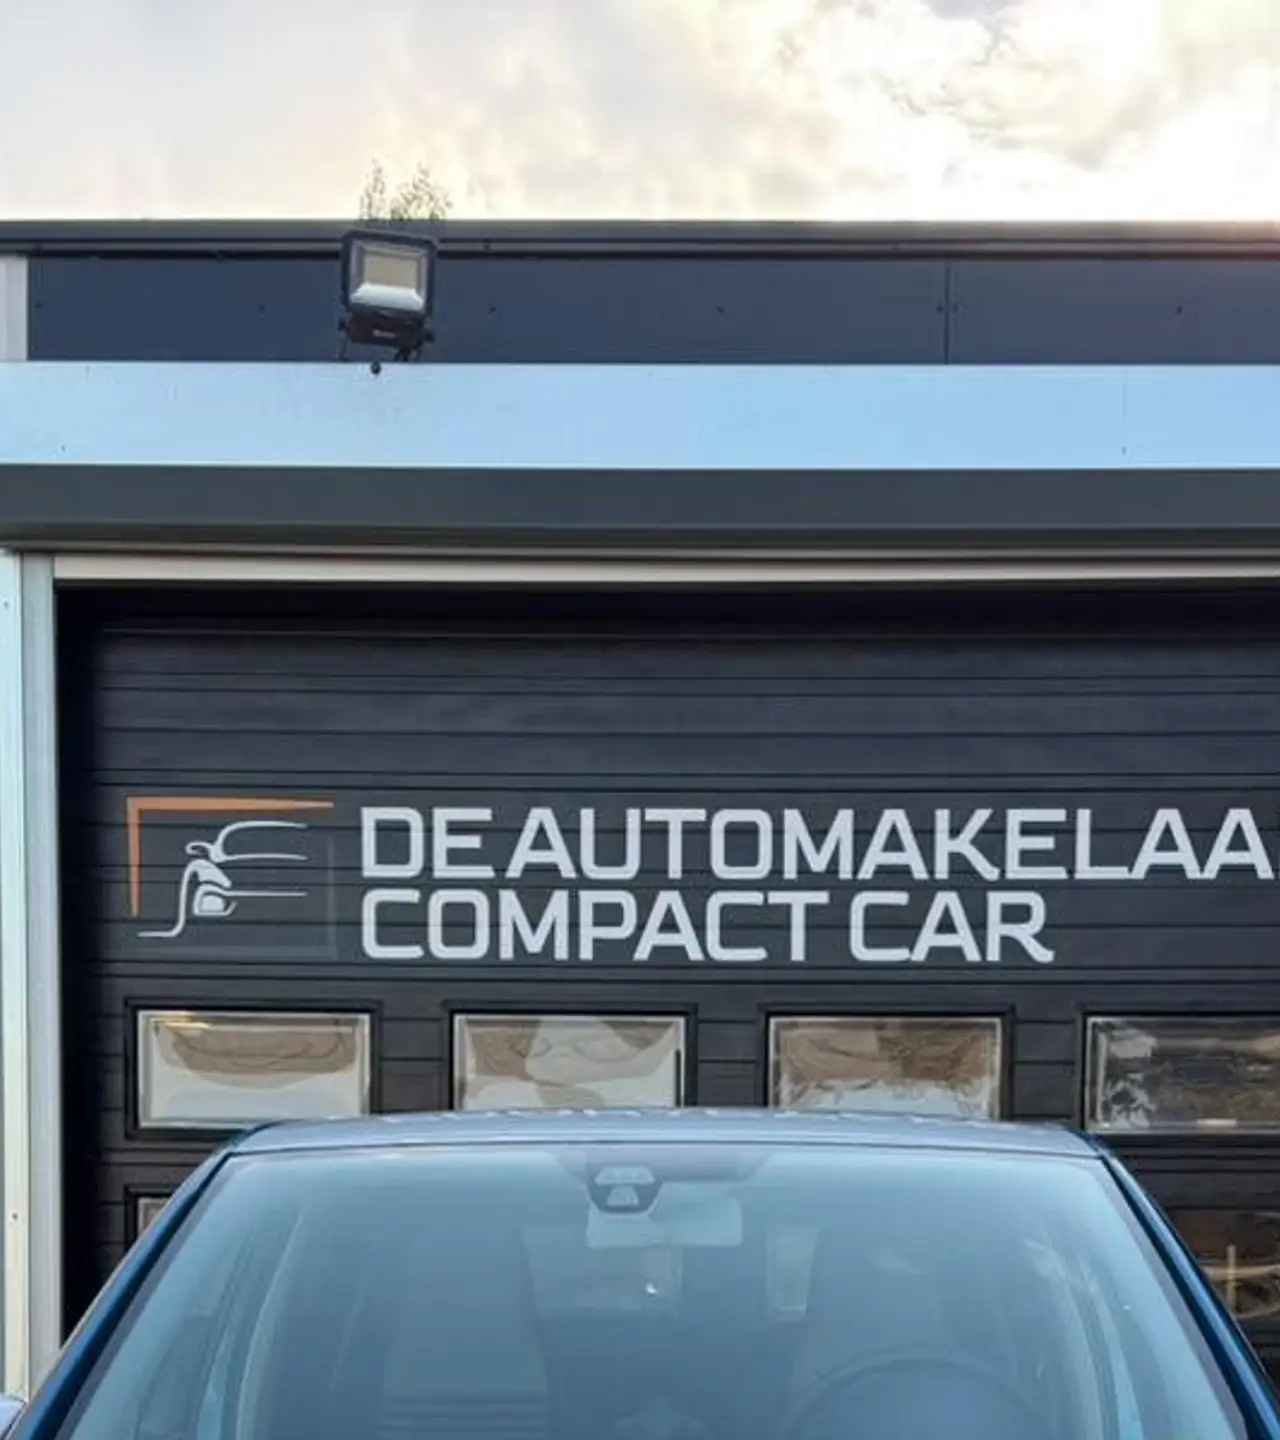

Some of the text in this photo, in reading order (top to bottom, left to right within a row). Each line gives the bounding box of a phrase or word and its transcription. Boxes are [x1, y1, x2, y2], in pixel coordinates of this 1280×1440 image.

[361, 807, 495, 880] DE
[362, 889, 1054, 963] COMPACT CAR
